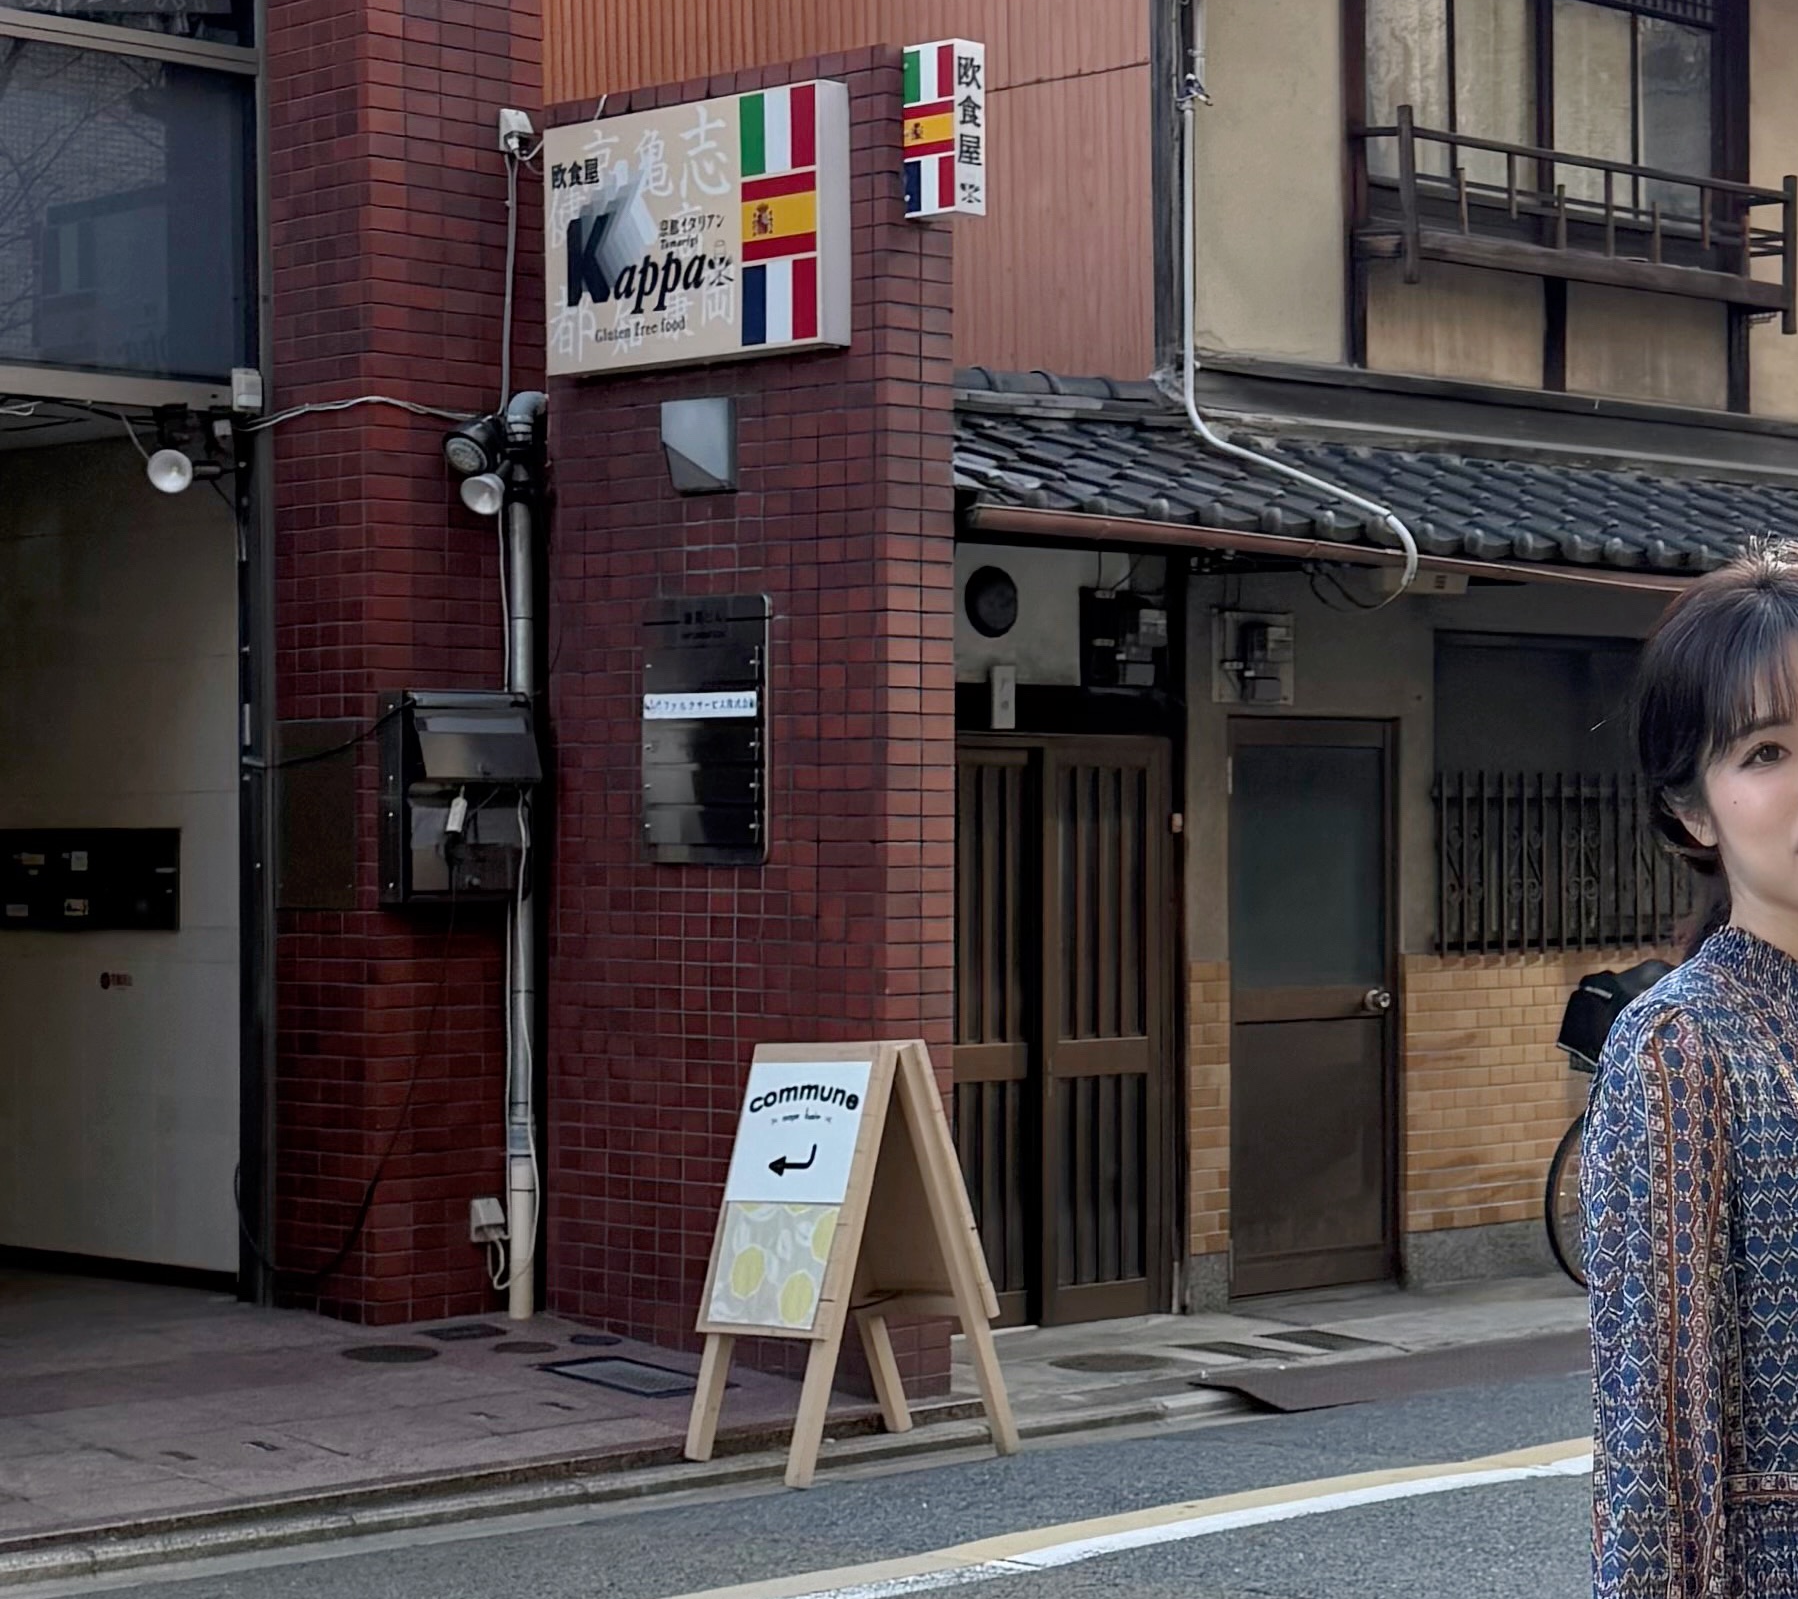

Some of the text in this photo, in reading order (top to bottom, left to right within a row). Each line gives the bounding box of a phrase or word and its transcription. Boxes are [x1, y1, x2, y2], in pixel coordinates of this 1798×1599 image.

[956, 55, 982, 167] 欧食屋
[551, 157, 600, 190] 欧食屋
[566, 210, 707, 315] Kappa
[749, 1084, 859, 1113] commune
